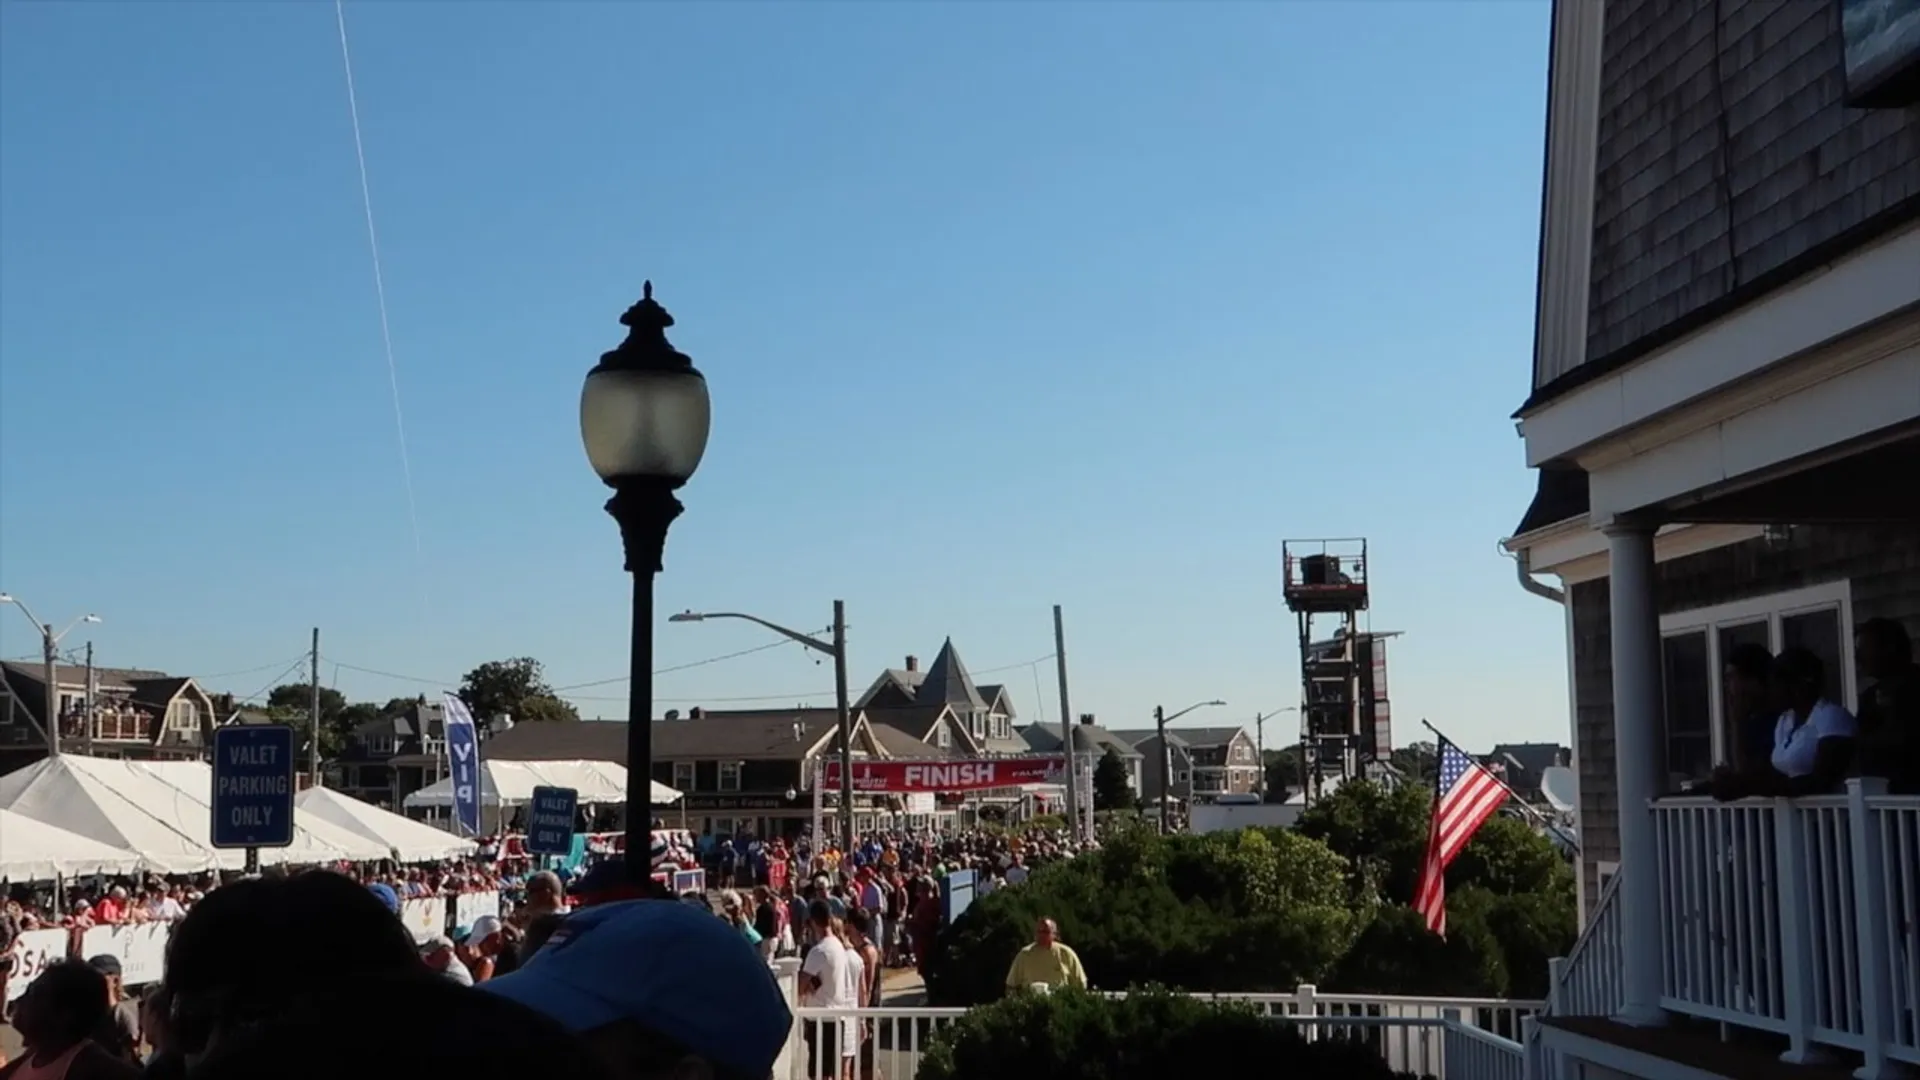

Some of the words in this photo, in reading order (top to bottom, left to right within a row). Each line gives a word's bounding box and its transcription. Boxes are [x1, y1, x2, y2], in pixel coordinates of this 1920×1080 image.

[229, 745, 278, 765] VALET
[904, 763, 995, 787] FINISH
[219, 775, 287, 796] PARKING
[541, 797, 568, 811] VALET
[231, 805, 273, 827] ONLY
[534, 811, 571, 828] PARKING
[538, 829, 564, 845] ONLY
